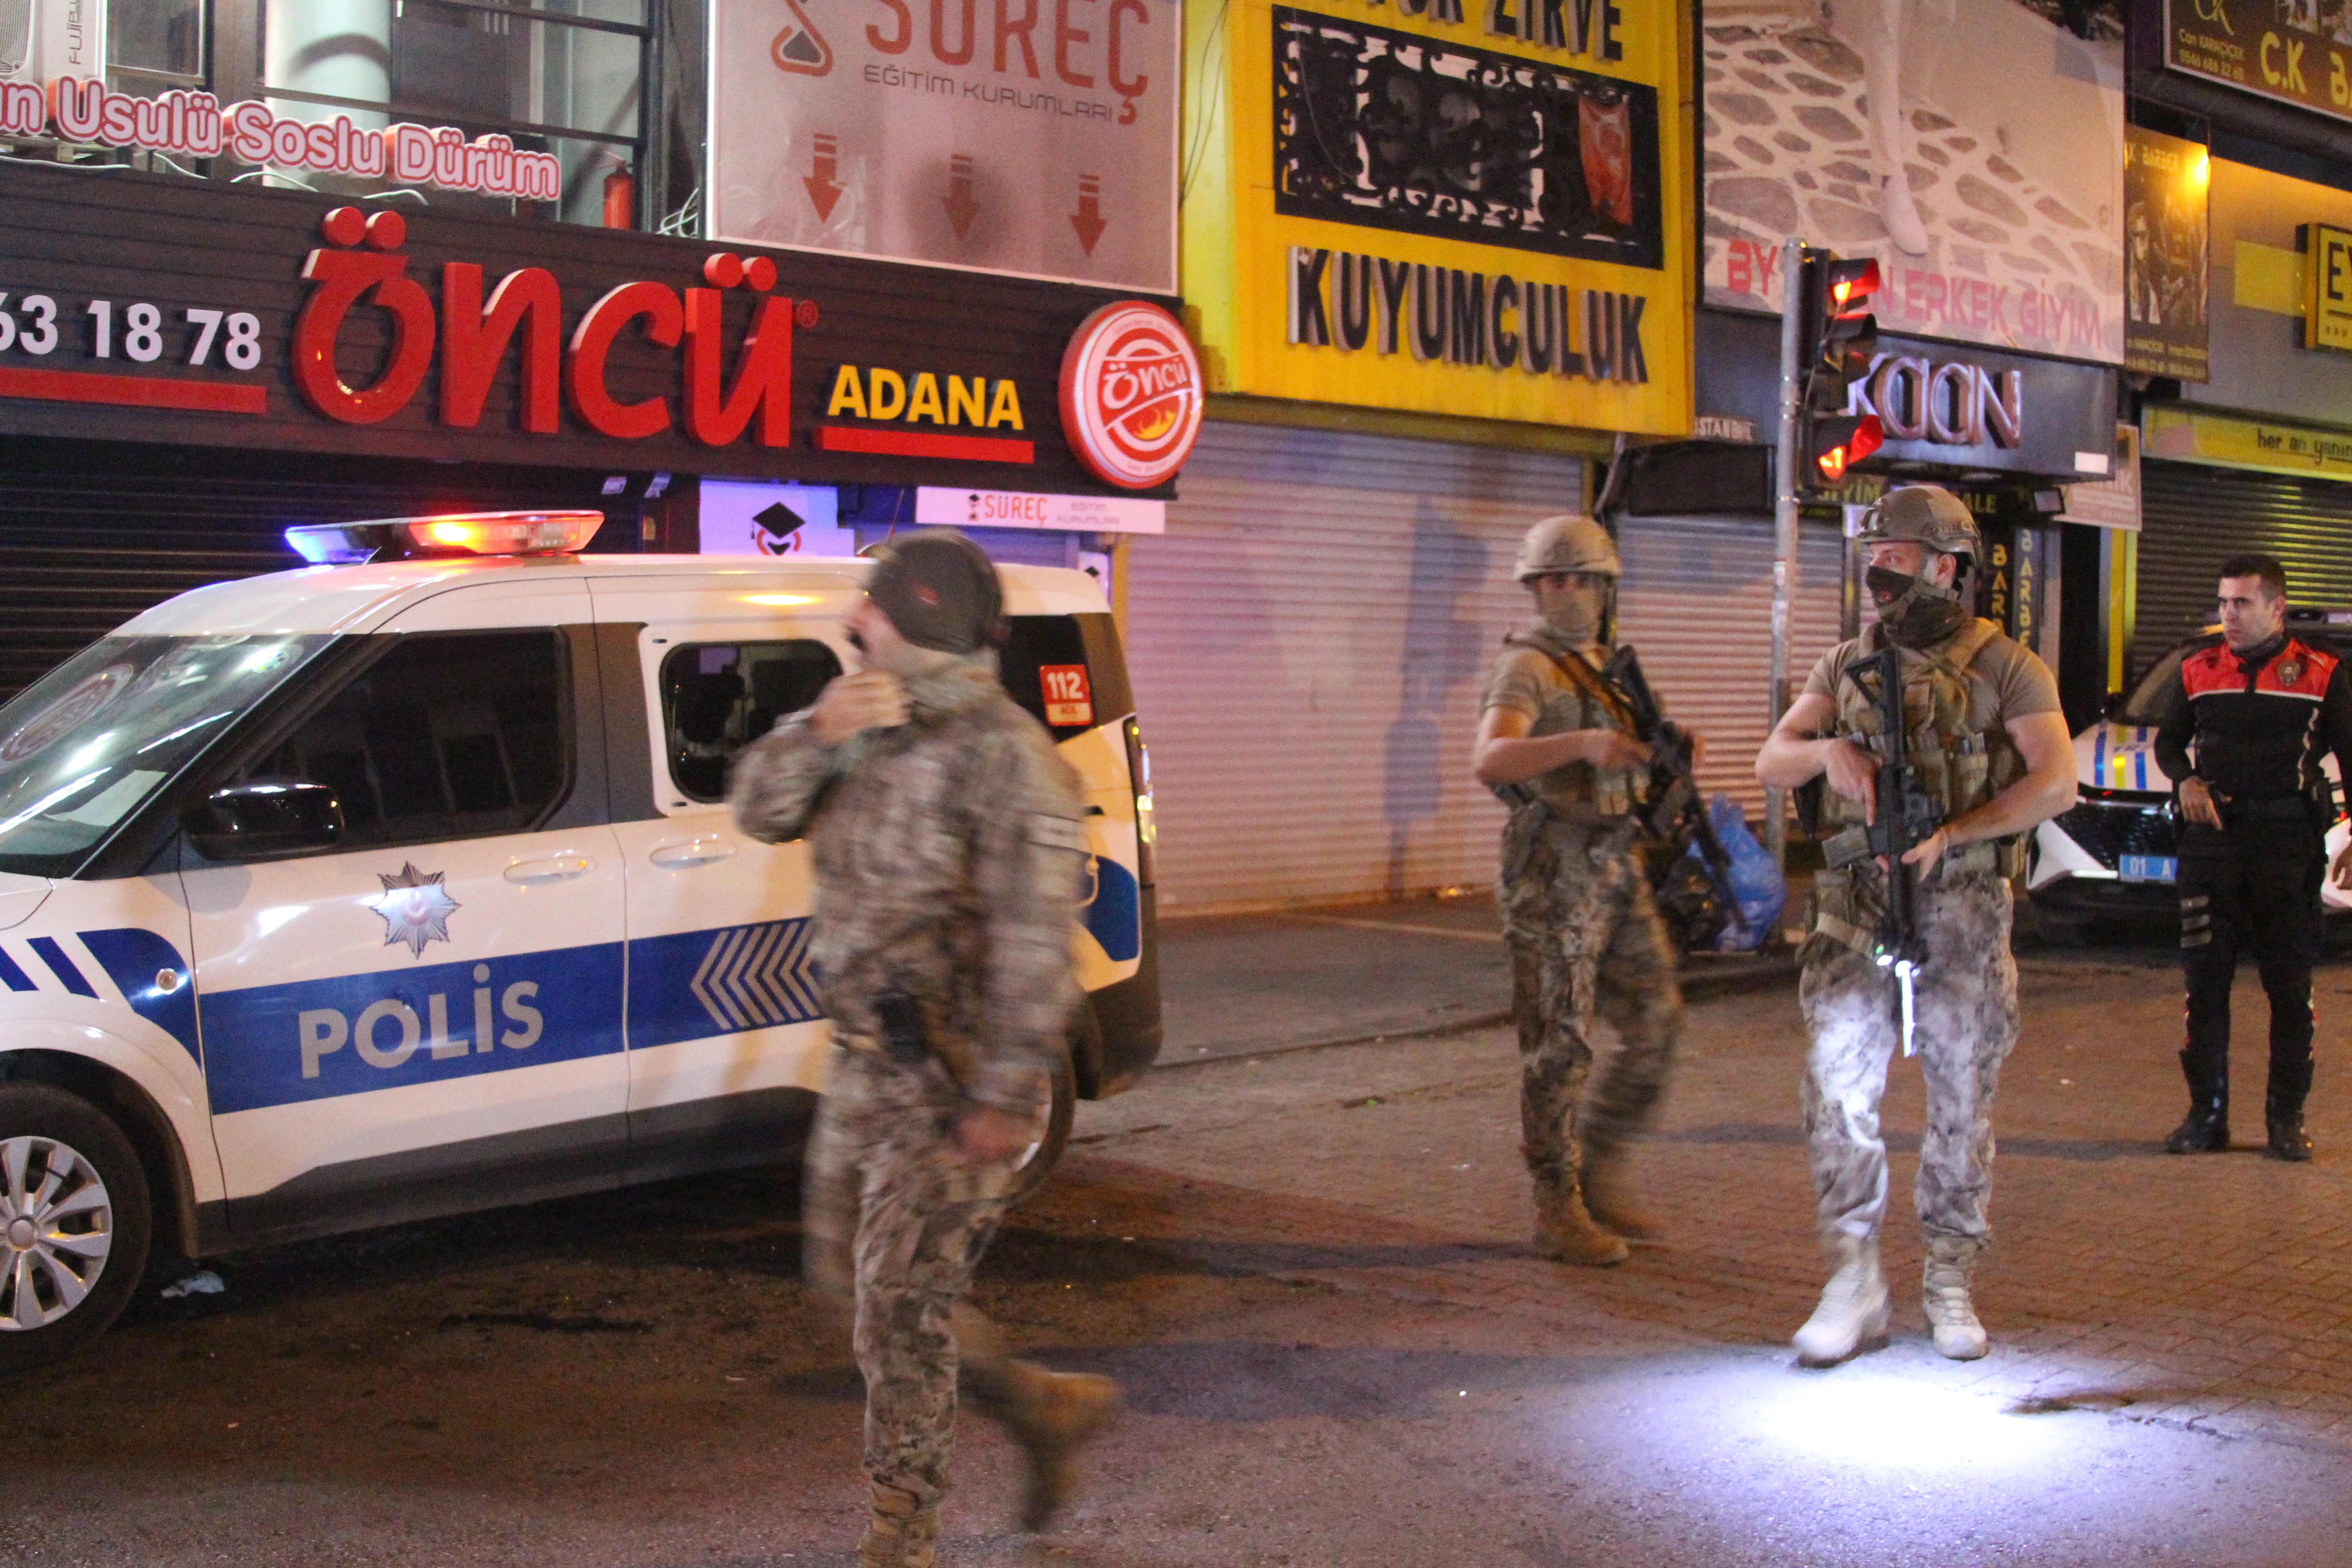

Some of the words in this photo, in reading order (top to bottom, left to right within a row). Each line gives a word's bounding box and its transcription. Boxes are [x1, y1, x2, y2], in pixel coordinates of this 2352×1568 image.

[0, 78, 44, 136] n
[56, 74, 222, 158] Usulü
[232, 101, 384, 178] Soslu
[394, 122, 561, 201] Dürüm
[87, 299, 163, 363] 18
[186, 309, 262, 370] 78
[1287, 245, 1649, 383] KUYUMCULUK
[1906, 269, 2014, 335] ERKEK
[2019, 278, 2102, 349] GİYİM
[828, 364, 1024, 430] ADANA
[985, 494, 1049, 527] SÜREÇ
[1046, 671, 1083, 699] 112
[299, 963, 544, 1079] POLİS
